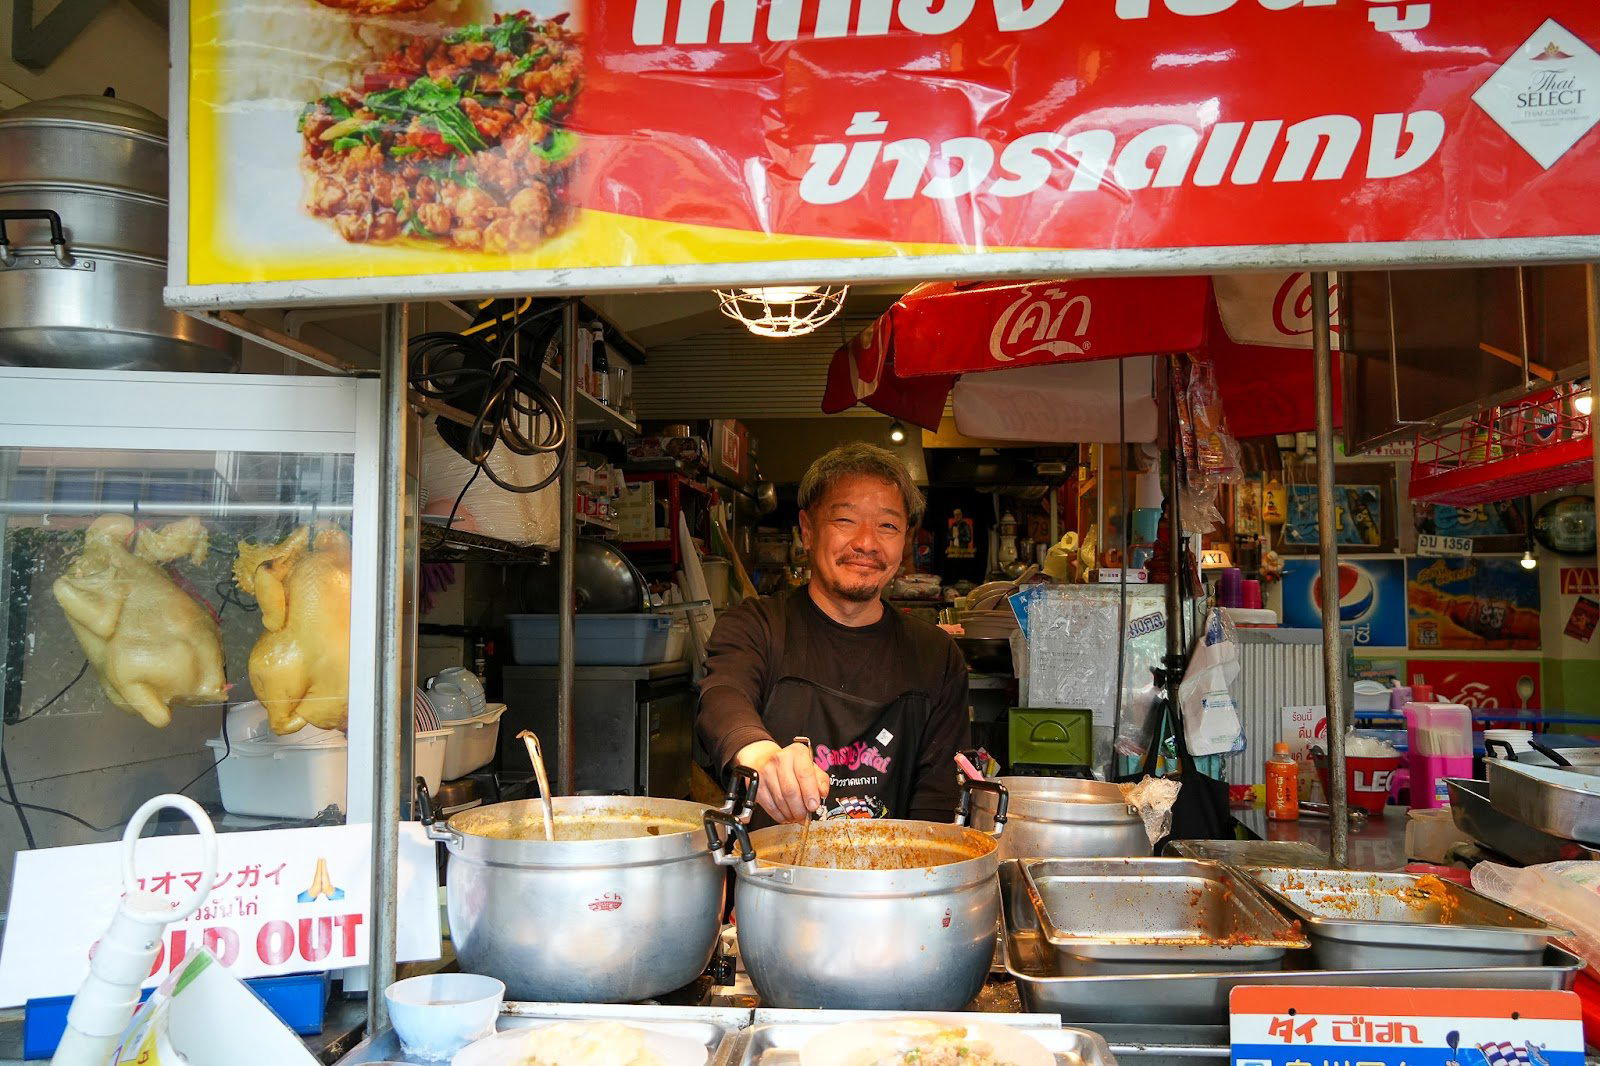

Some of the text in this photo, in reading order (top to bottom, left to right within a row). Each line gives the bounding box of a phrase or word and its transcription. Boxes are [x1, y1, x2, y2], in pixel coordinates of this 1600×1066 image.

[1528, 68, 1576, 91] Thai
[1516, 89, 1586, 108] SELECT
[799, 111, 1446, 205] ข้าวราดแกง
[990, 286, 1092, 361] โค้ก
[1443, 537, 1471, 551] 1356
[256, 914, 363, 966] OUT
[1268, 1016, 1423, 1044] タイ ごはん
